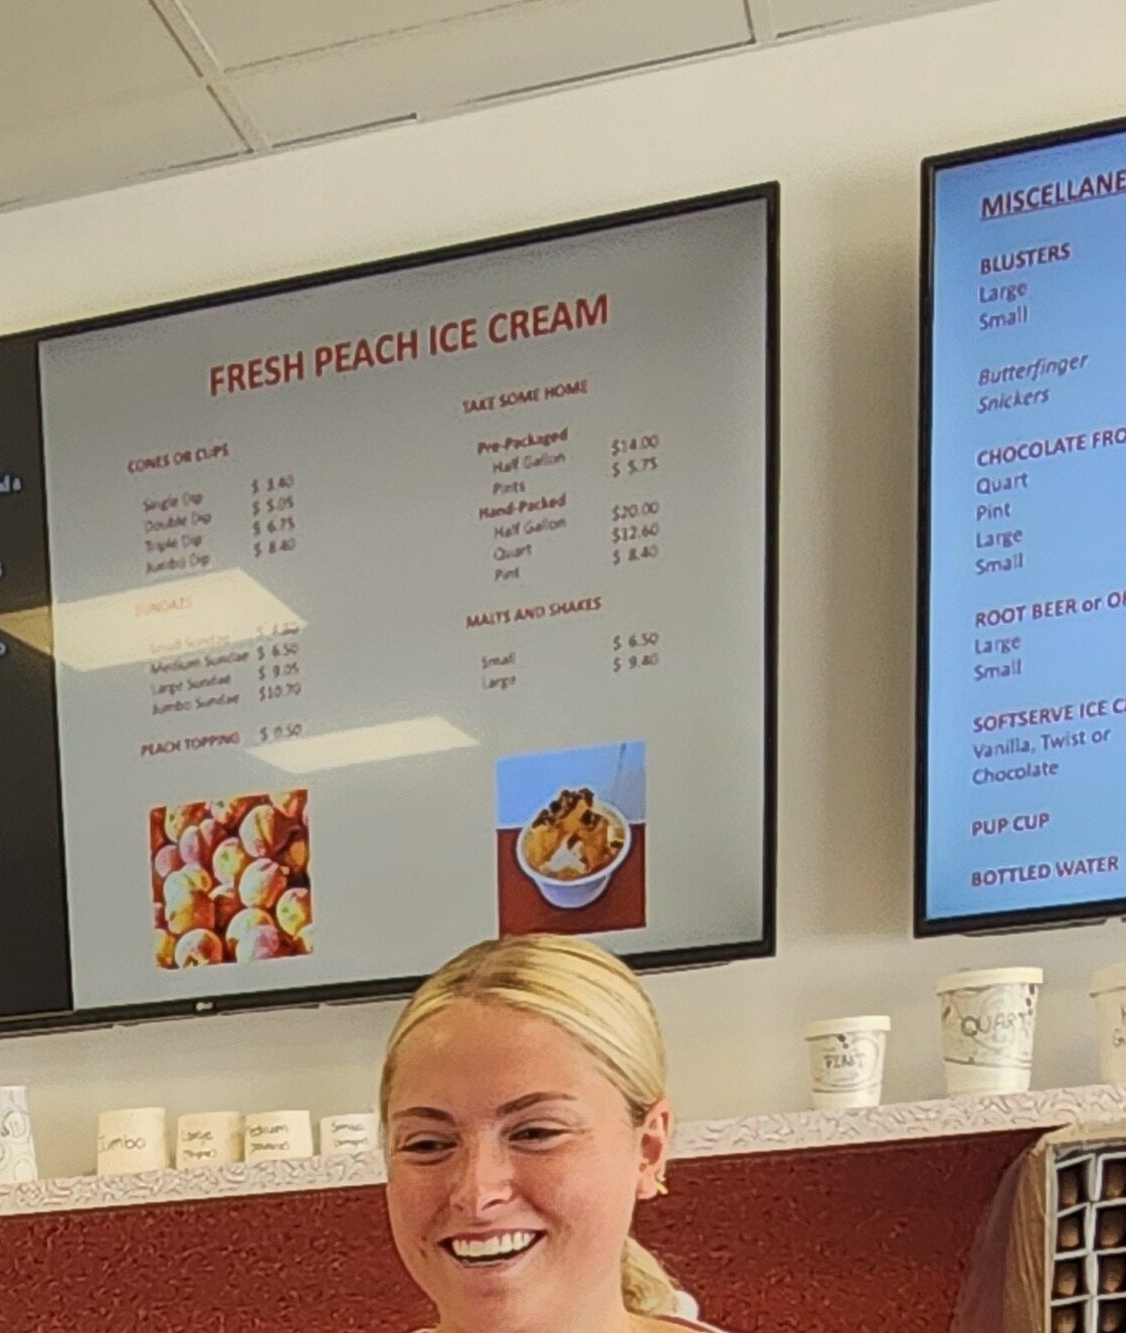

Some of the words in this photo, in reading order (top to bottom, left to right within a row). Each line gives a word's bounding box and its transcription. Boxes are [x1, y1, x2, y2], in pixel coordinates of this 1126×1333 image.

[980, 168, 1126, 219] MISCELLANE
[980, 242, 1071, 276] BLUSTERS
[979, 282, 1028, 304] Large
[979, 305, 1028, 331] Small
[210, 350, 305, 398] FRESH
[314, 328, 418, 378] PEACH
[429, 318, 479, 356] ICE
[489, 293, 609, 345] CREAM
[978, 354, 1089, 386] Butterfinger
[544, 379, 588, 400] HOME
[977, 388, 1050, 414] Snickers
[477, 427, 569, 456] Pre-Packaged
[977, 433, 1087, 468] CHOCOLATE
[976, 472, 1029, 495] Quart
[478, 491, 567, 520] Hand-Packed
[976, 502, 1011, 521] Pint
[976, 529, 1024, 549] Large
[975, 552, 1024, 576] Small
[514, 605, 545, 622] AND
[548, 595, 603, 617] SHAKES
[975, 605, 1027, 629] ROOT
[1032, 598, 1077, 620] BEER
[1082, 597, 1102, 613] or
[974, 636, 1022, 656] Large
[974, 659, 1022, 681] Small
[973, 704, 1073, 733] SOFTSERVE
[1080, 700, 1109, 719] ICE
[972, 738, 1035, 759] Vanilla,
[1040, 730, 1086, 751] Twist
[1091, 728, 1111, 744] or
[972, 762, 1059, 785] Chocolate
[971, 818, 1009, 837] PUP
[1012, 812, 1050, 832] CUP
[970, 863, 1051, 888] BOTTLED
[1055, 855, 1119, 878] WATER
[961, 1010, 1031, 1036] QUART
[825, 1054, 863, 1069] PINT
